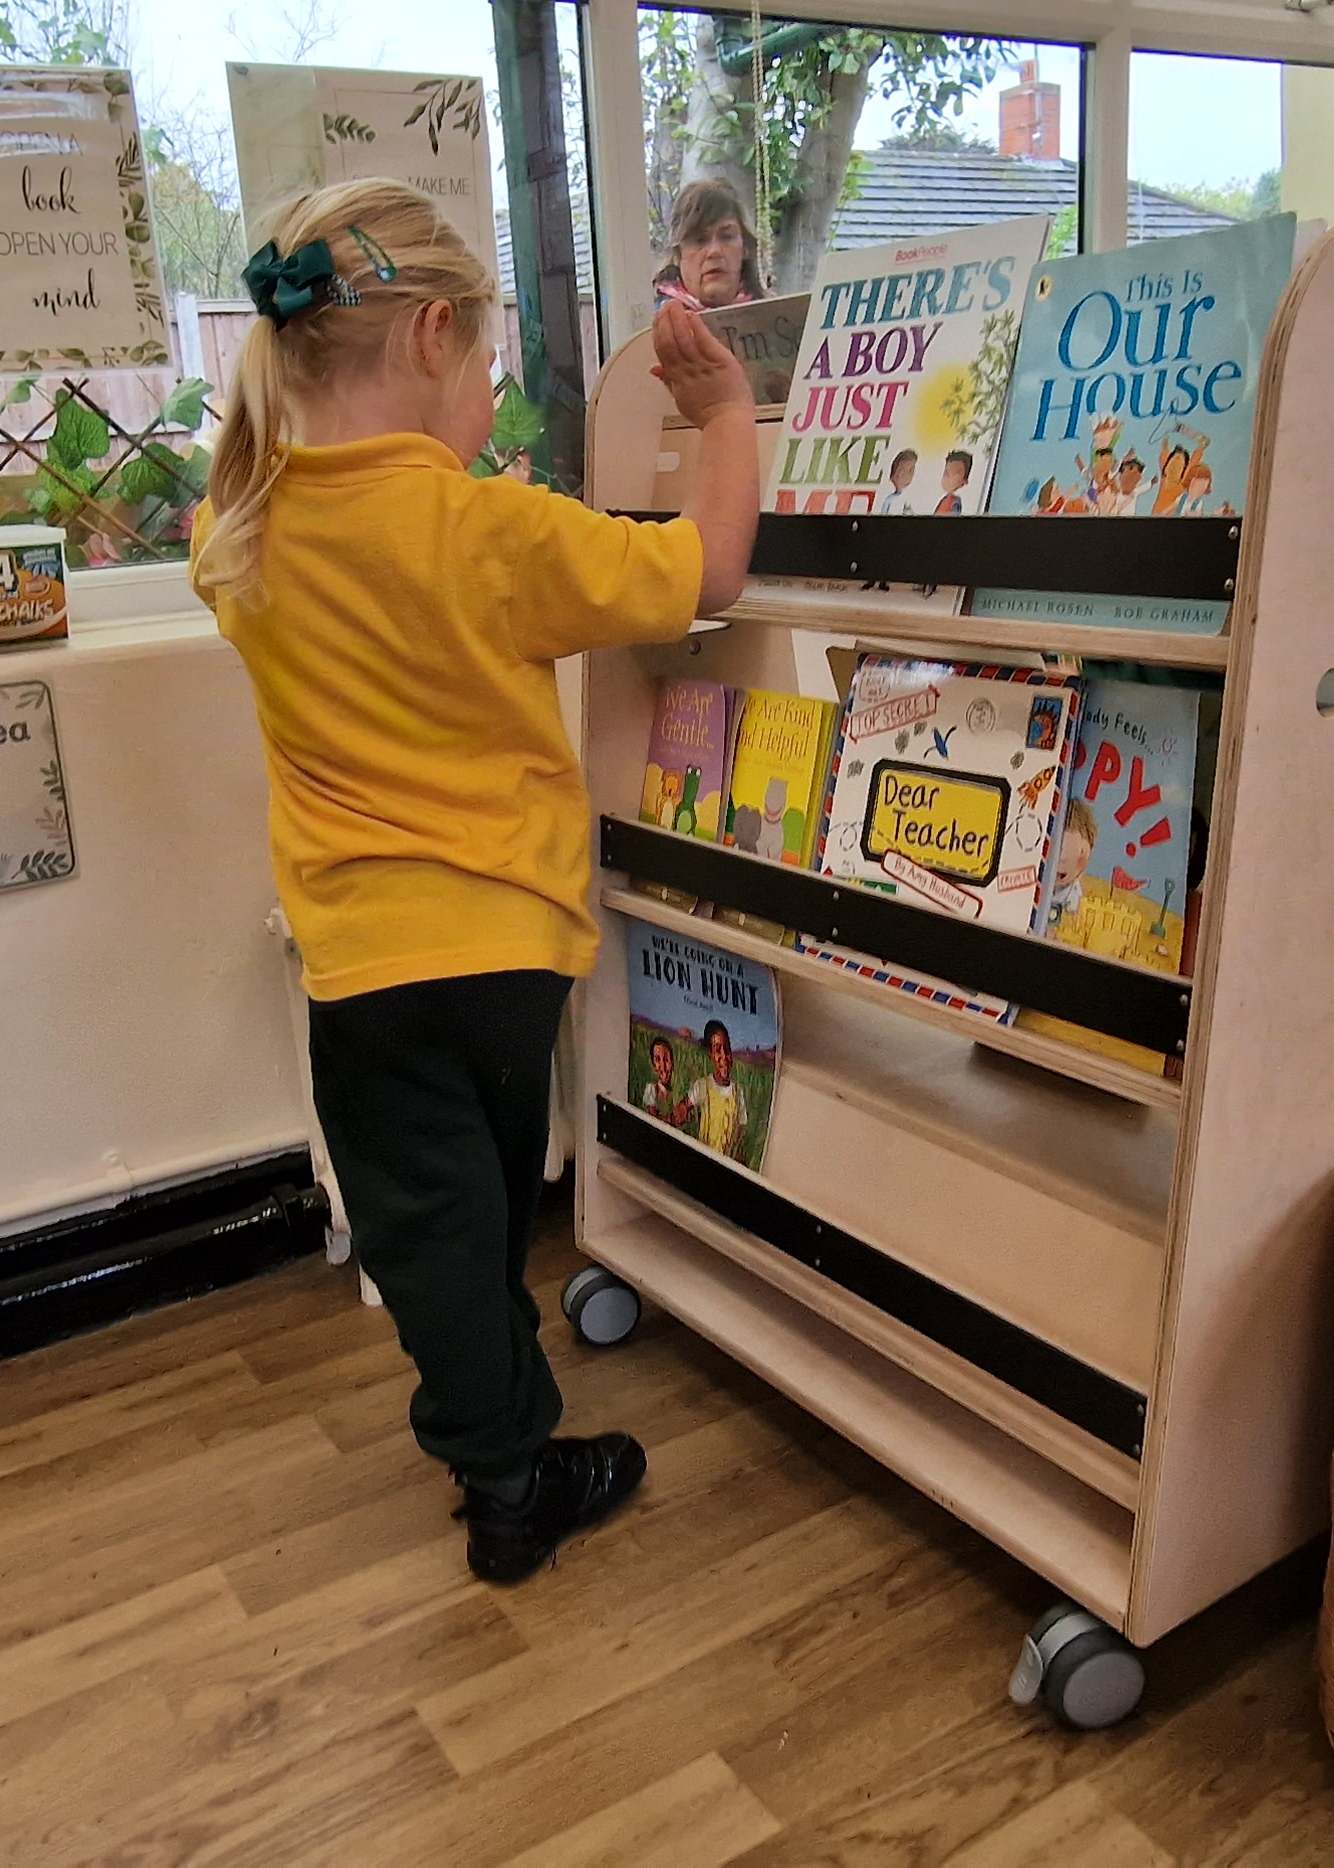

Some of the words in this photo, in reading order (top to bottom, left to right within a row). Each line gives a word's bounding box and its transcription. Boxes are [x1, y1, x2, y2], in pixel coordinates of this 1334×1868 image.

[22, 165, 82, 214] book
[450, 177, 471, 196] ME
[59, 231, 119, 257] YOUR
[32, 267, 101, 316] mind
[820, 255, 1016, 330] THERE'S
[1124, 272, 1173, 302] This
[1182, 270, 1204, 294] Is
[803, 337, 834, 380] A
[842, 321, 944, 378] BOY
[1057, 290, 1217, 372] Our
[791, 381, 910, 433] JUST
[1029, 360, 1243, 442] House
[778, 435, 892, 485] LIKE
[980, 599, 1040, 613] MICHAEL
[1046, 600, 1095, 617] ROSEN
[1149, 608, 1215, 624] GRAHAM
[666, 686, 687, 709] We
[689, 688, 714, 716] Are
[758, 699, 781, 722] Are
[784, 699, 817, 731] Kind
[854, 708, 881, 734] TOP
[882, 695, 935, 723] SECRET
[759, 727, 812, 761] Helpful
[884, 774, 941, 811] Dear
[892, 810, 989, 857] Teacher
[894, 857, 906, 875] By
[907, 865, 927, 889] Amy
[929, 877, 967, 909] Husband
[642, 948, 692, 991] LION
[700, 968, 761, 1015] HUNT
[736, 963, 745, 979] A
